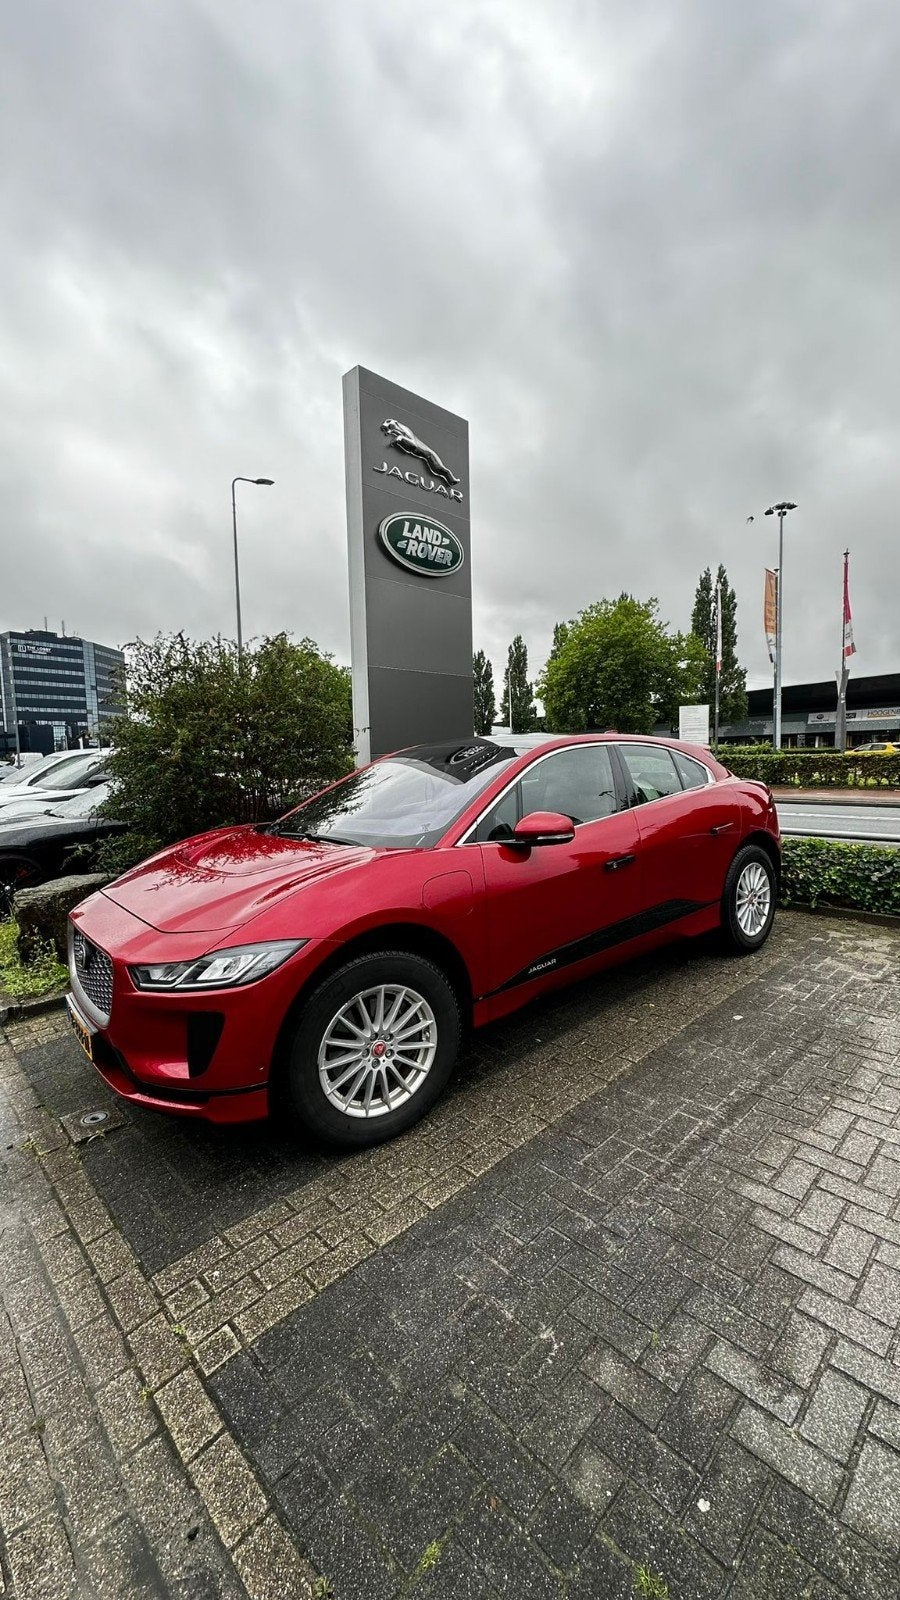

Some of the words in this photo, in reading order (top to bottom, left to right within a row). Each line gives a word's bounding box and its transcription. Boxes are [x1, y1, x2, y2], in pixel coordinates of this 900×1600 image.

[373, 462, 463, 503] JAGUAR
[402, 521, 443, 546] LAND
[405, 540, 453, 566] ROVER
[528, 958, 557, 974] JAGUAR
